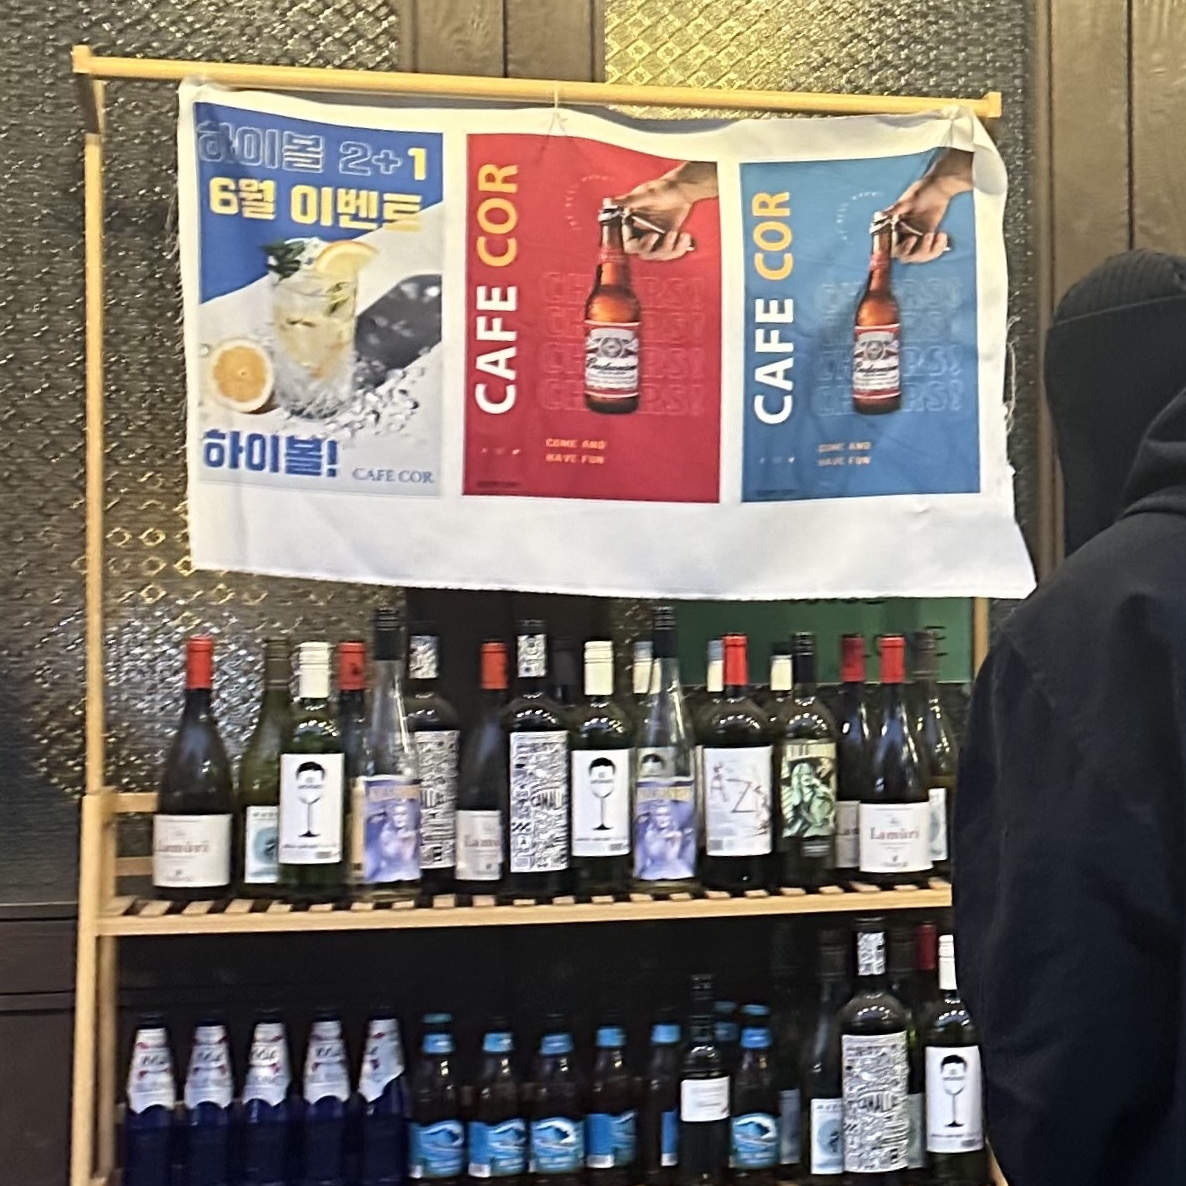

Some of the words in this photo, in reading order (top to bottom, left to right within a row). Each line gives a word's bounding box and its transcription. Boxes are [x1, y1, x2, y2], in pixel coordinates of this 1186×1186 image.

[196, 121, 325, 173] 하이볼
[338, 141, 427, 180] 2+1
[209, 177, 276, 220] 6월
[290, 184, 423, 232] 이벤트
[477, 164, 518, 266] COR
[752, 191, 794, 280] COR
[475, 285, 518, 414] CAFE
[753, 299, 794, 424] CAFE
[203, 429, 338, 477] 하이볼!
[352, 468, 395, 482] CAFE
[398, 470, 434, 484] COR
